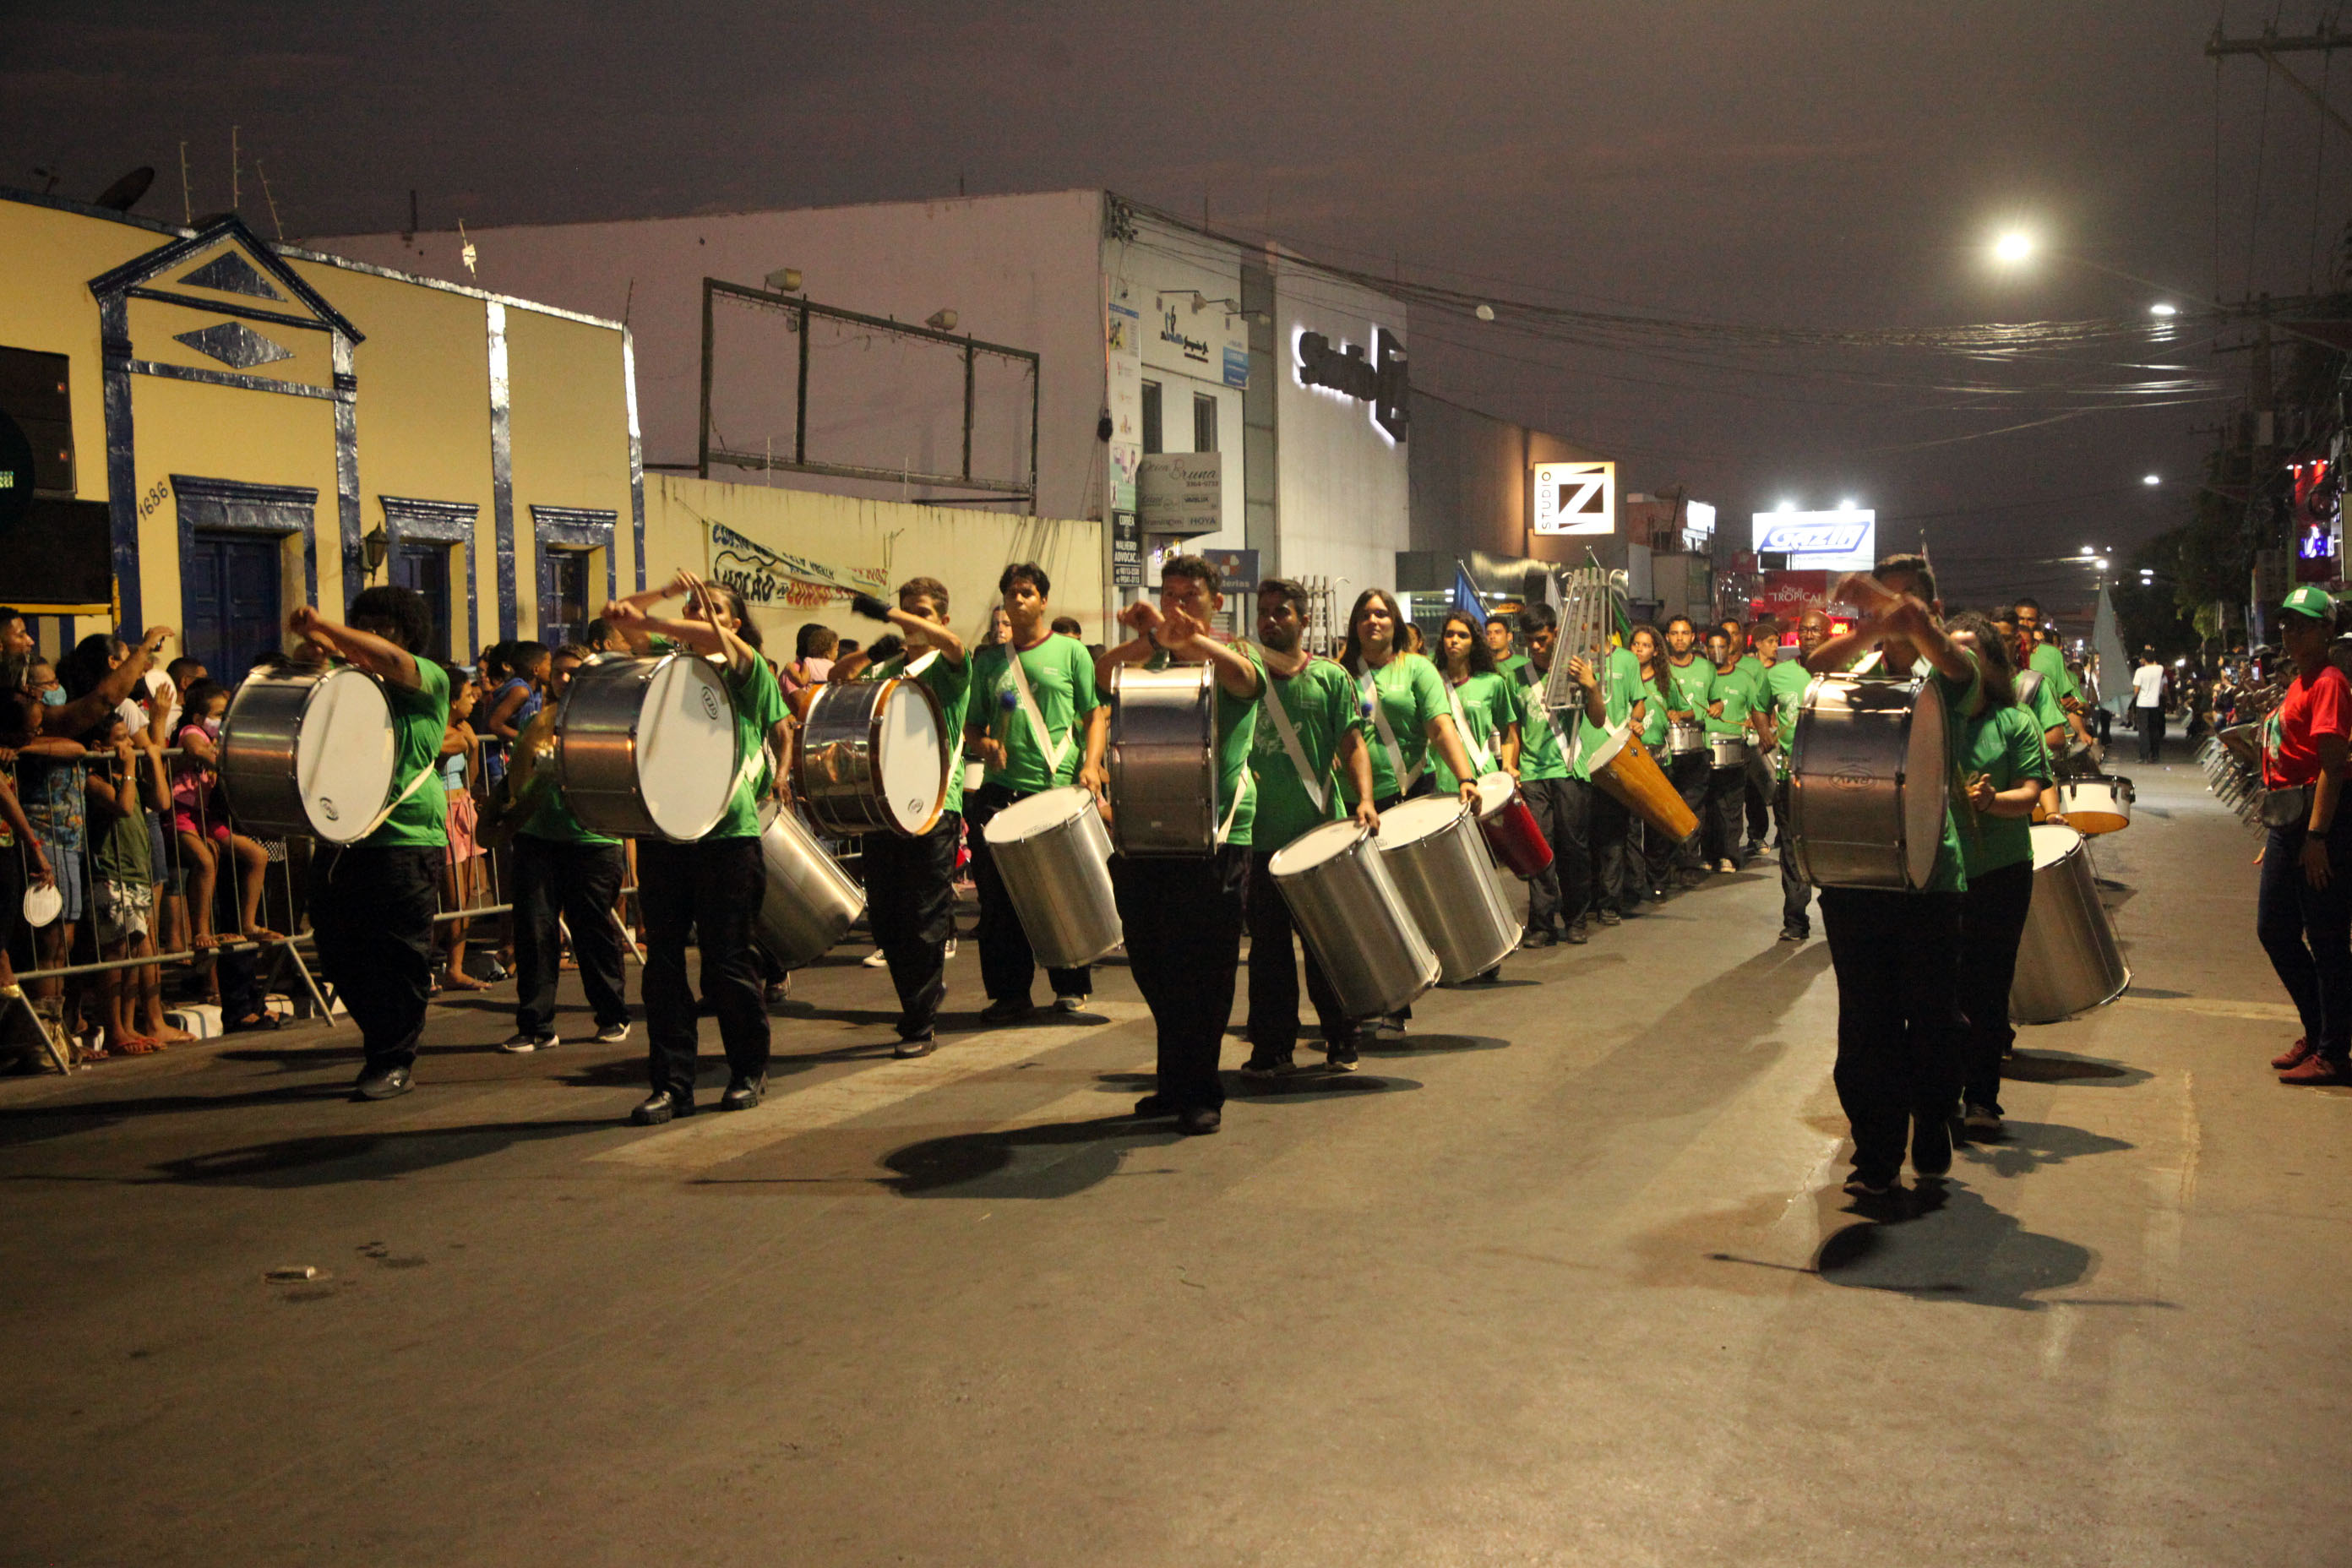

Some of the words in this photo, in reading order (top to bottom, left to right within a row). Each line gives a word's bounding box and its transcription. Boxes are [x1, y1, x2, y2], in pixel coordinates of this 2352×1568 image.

[139, 481, 168, 521] 1686
[1542, 471, 1551, 530] STUDIO
[1768, 592, 1823, 603] TROPICAL
